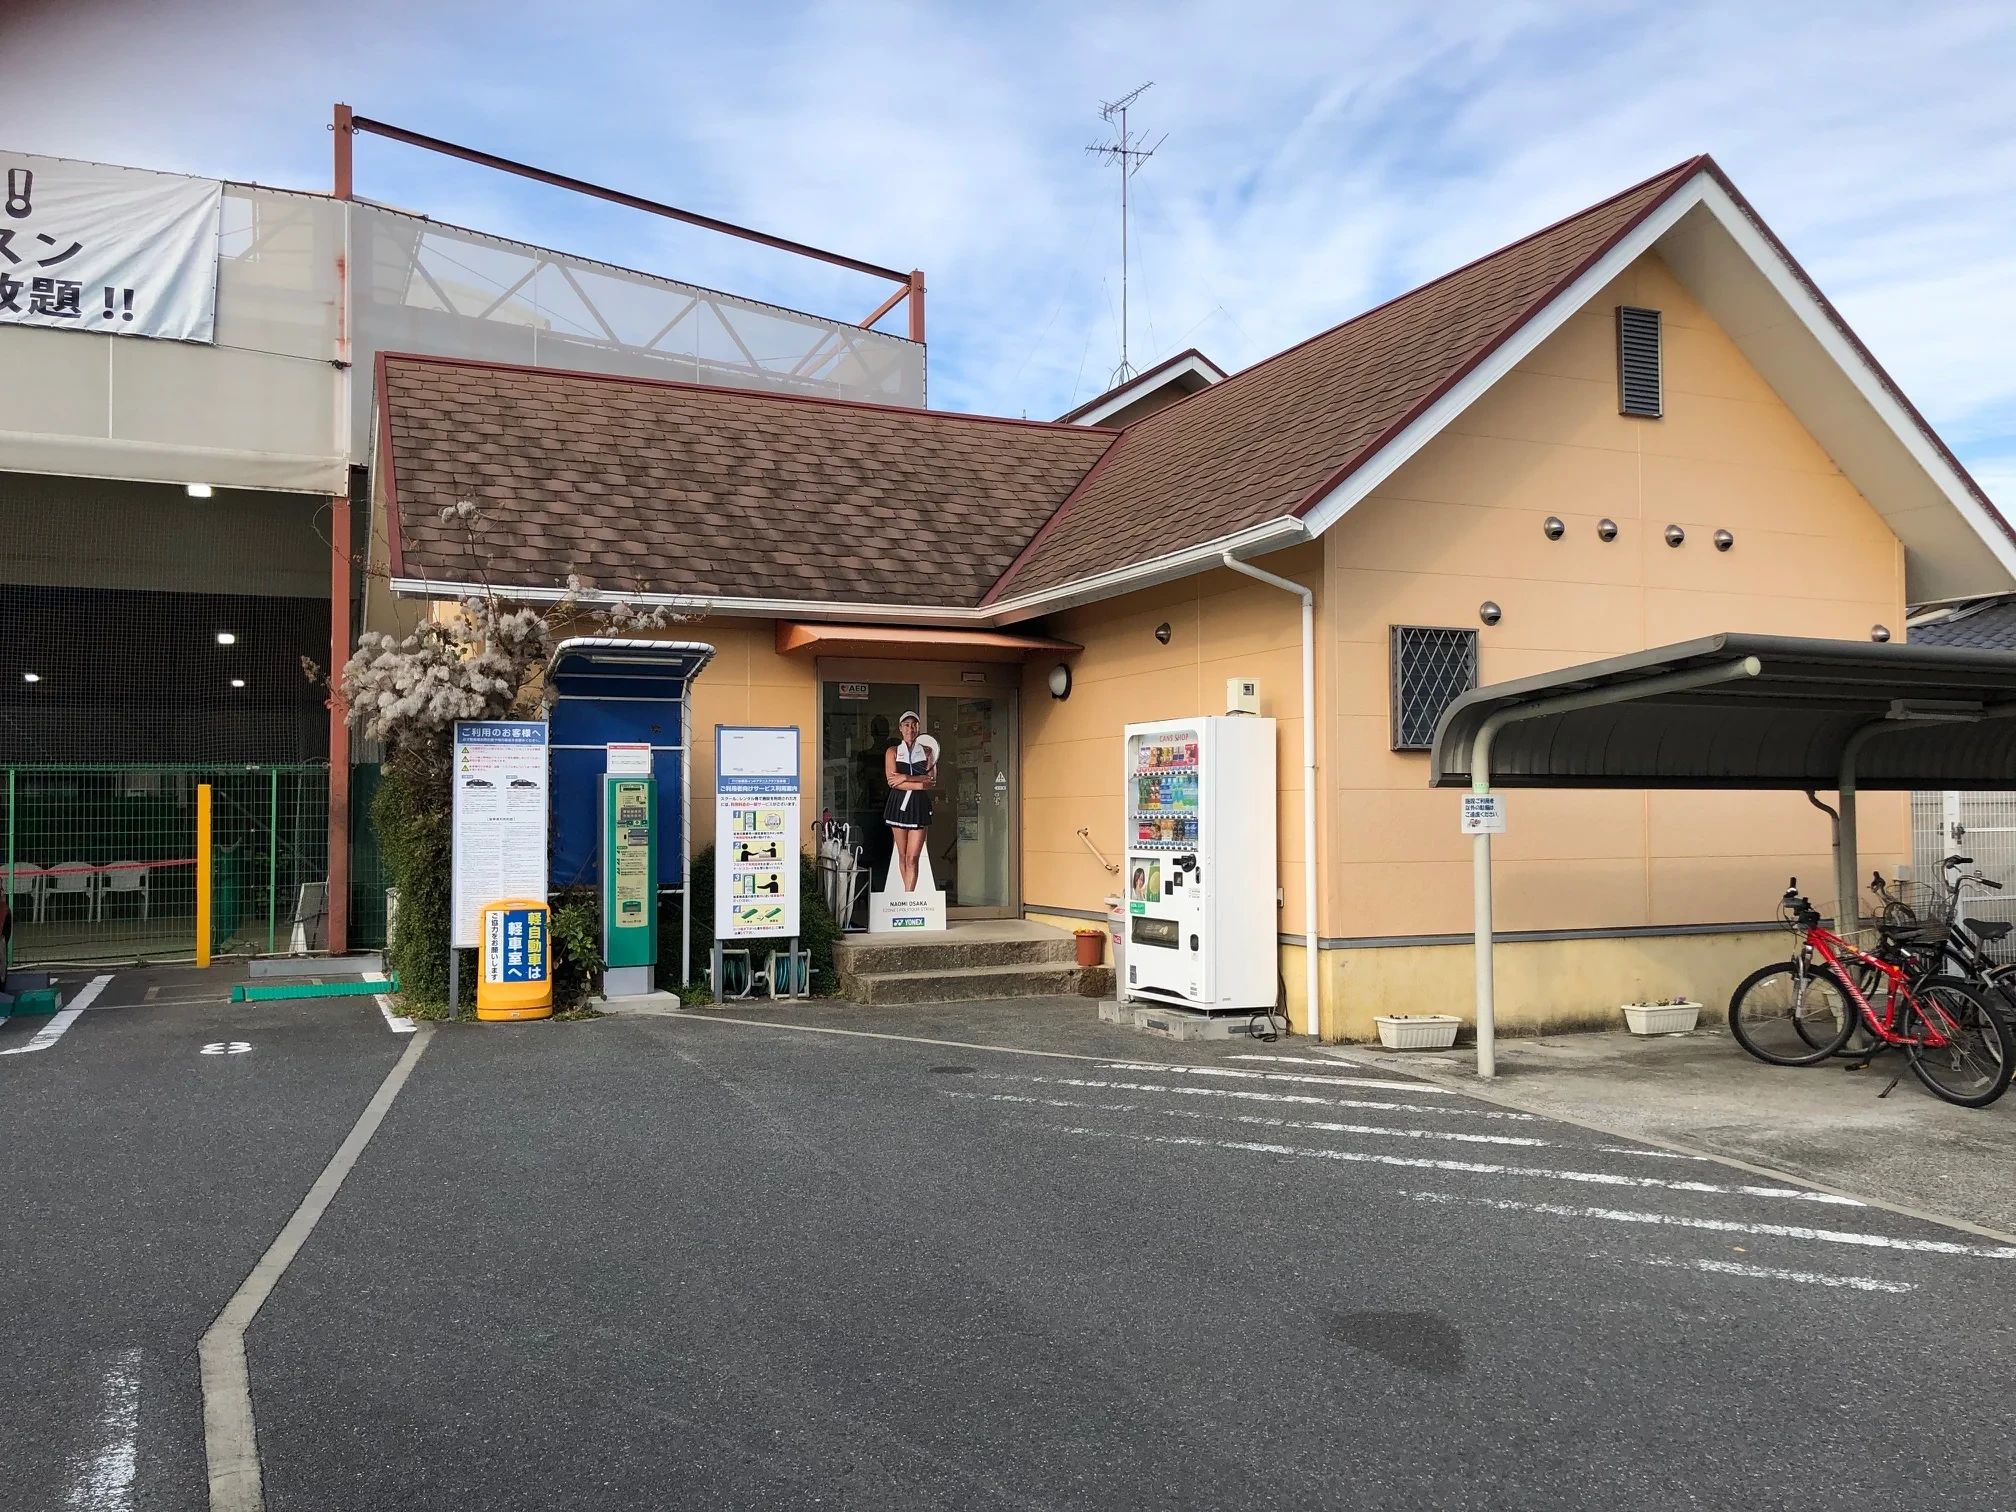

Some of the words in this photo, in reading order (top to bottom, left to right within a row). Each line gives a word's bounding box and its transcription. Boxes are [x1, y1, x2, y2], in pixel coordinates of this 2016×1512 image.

[462, 727, 541, 738] ご利用のお客様へ
[491, 912, 499, 981] ご協力をお願いします
[508, 921, 523, 977] 軽車室へ
[527, 912, 542, 979] 軽自動車は
[905, 918, 923, 926] YONEX
